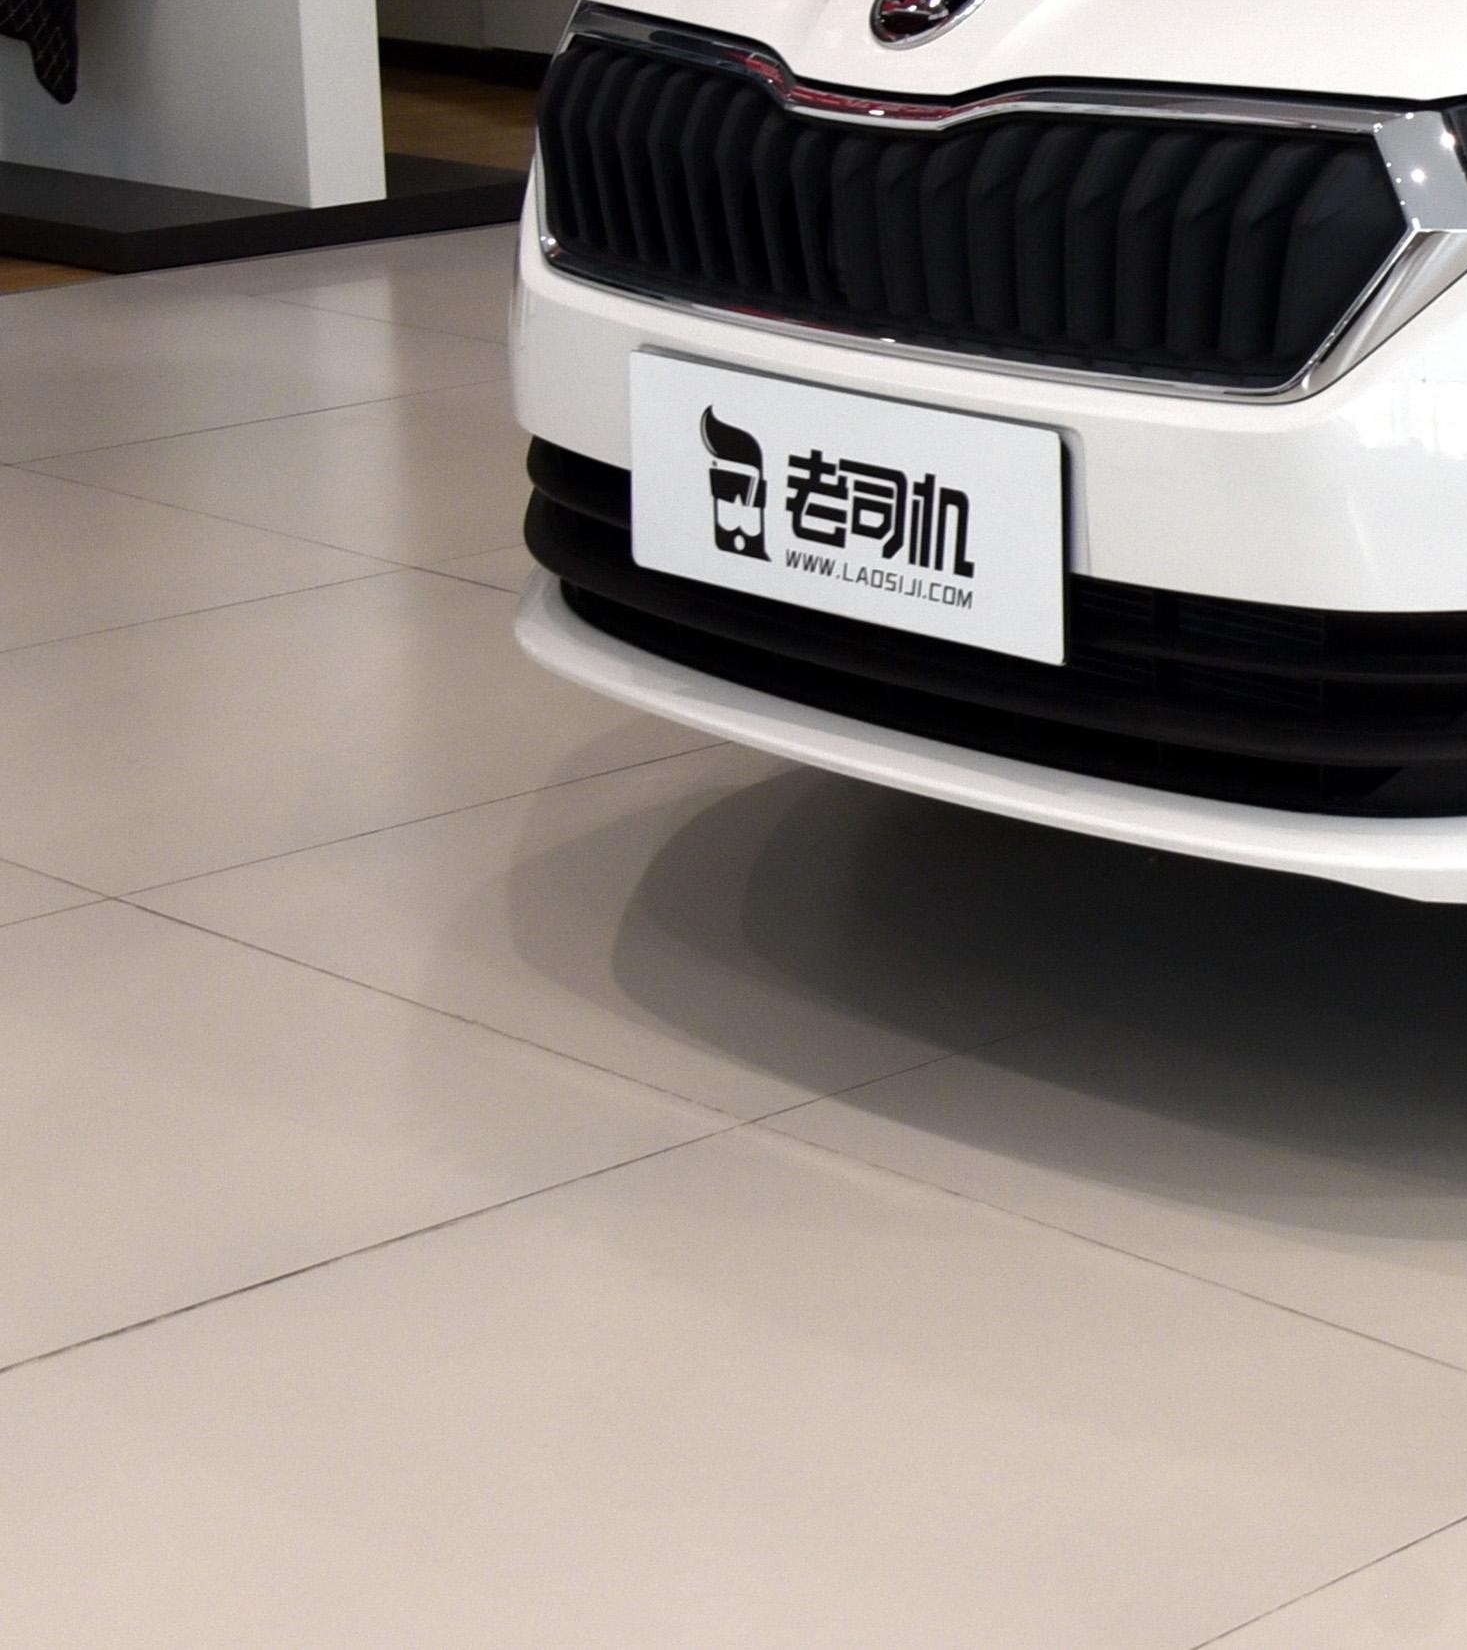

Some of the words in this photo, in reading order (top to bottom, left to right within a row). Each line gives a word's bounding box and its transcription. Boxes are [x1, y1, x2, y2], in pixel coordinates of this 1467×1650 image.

[784, 449, 976, 579] 老司机
[785, 549, 974, 610] WWW.LAOSIJI.COM
